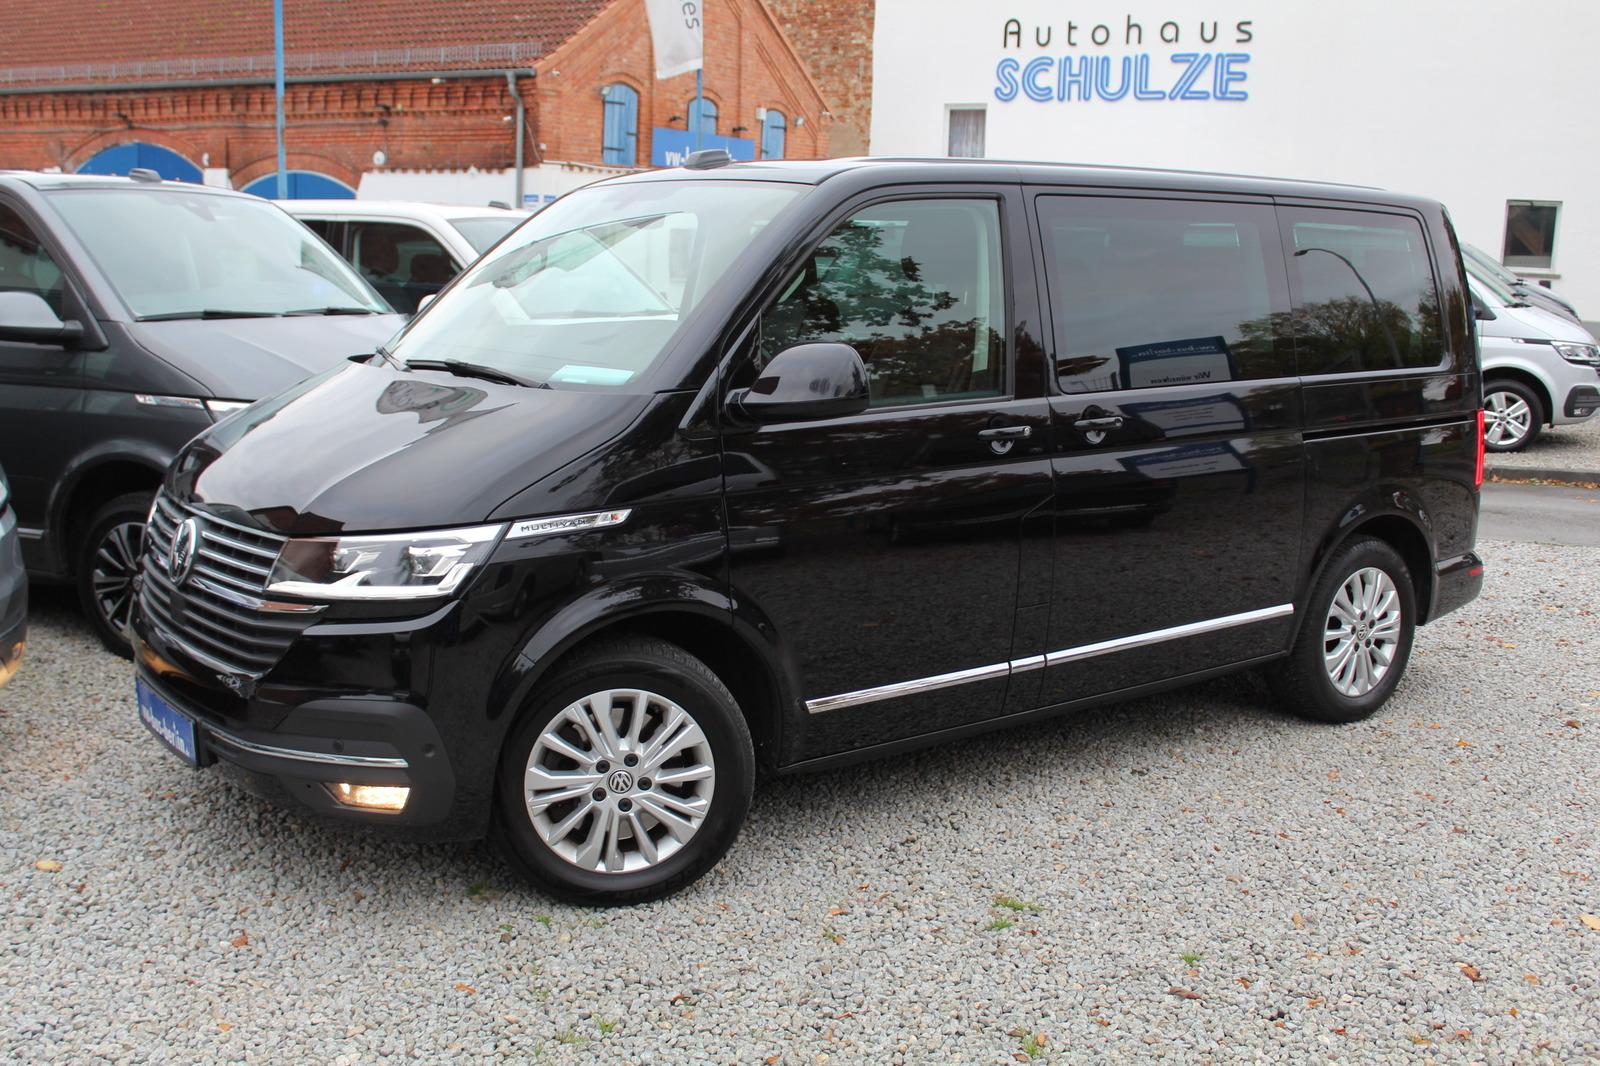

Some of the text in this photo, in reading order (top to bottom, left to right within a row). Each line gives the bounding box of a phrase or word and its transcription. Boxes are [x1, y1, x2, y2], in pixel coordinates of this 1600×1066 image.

[680, 0, 700, 30] es
[1003, 14, 1253, 48] Autohaus
[994, 53, 1251, 102] SCHULZE
